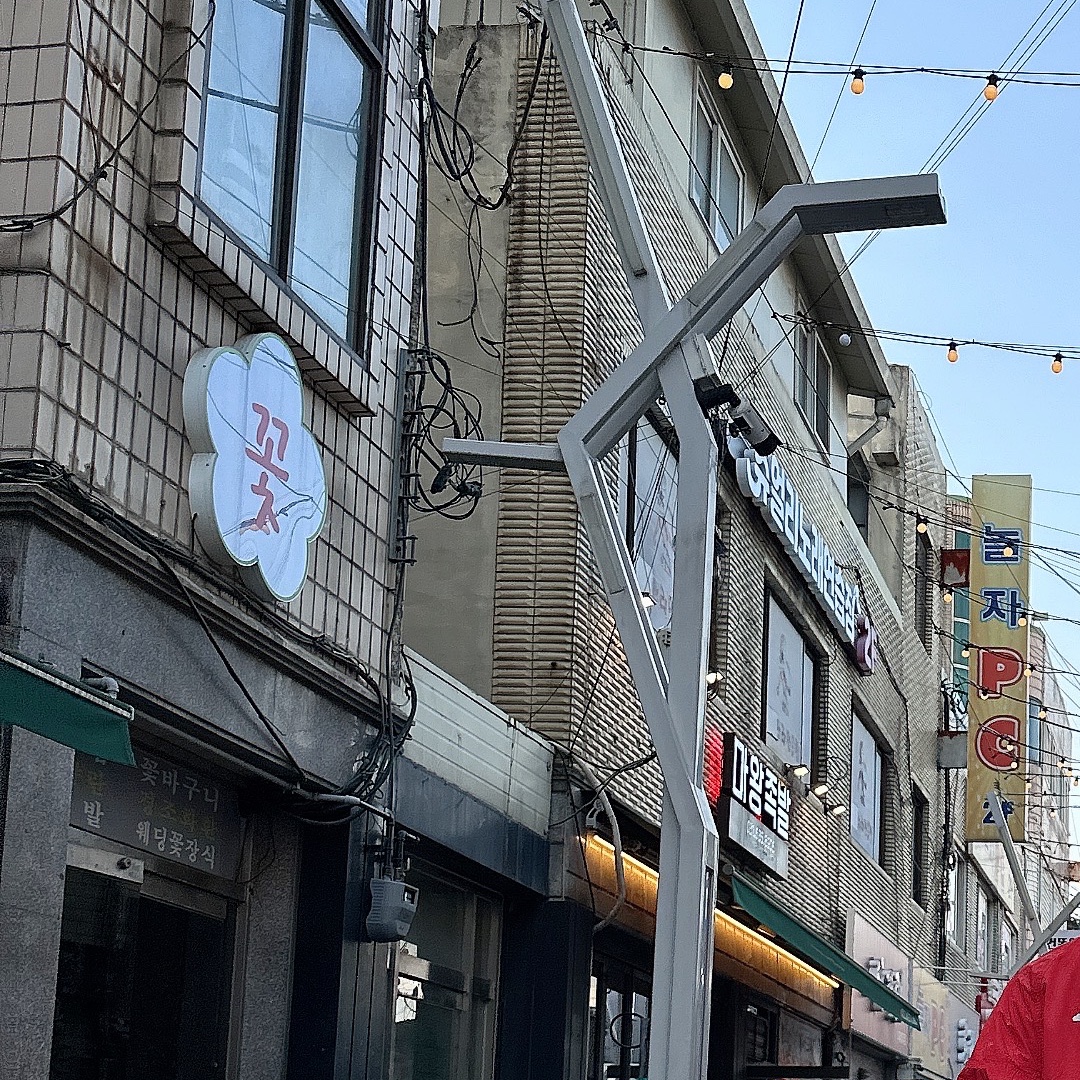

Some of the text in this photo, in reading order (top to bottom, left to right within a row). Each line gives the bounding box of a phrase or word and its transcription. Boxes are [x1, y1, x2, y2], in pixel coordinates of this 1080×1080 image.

[140, 756, 219, 813] 꽃바구니
[732, 735, 791, 841] 마왕족발
[136, 820, 216, 870] 웨딩꽃장식
